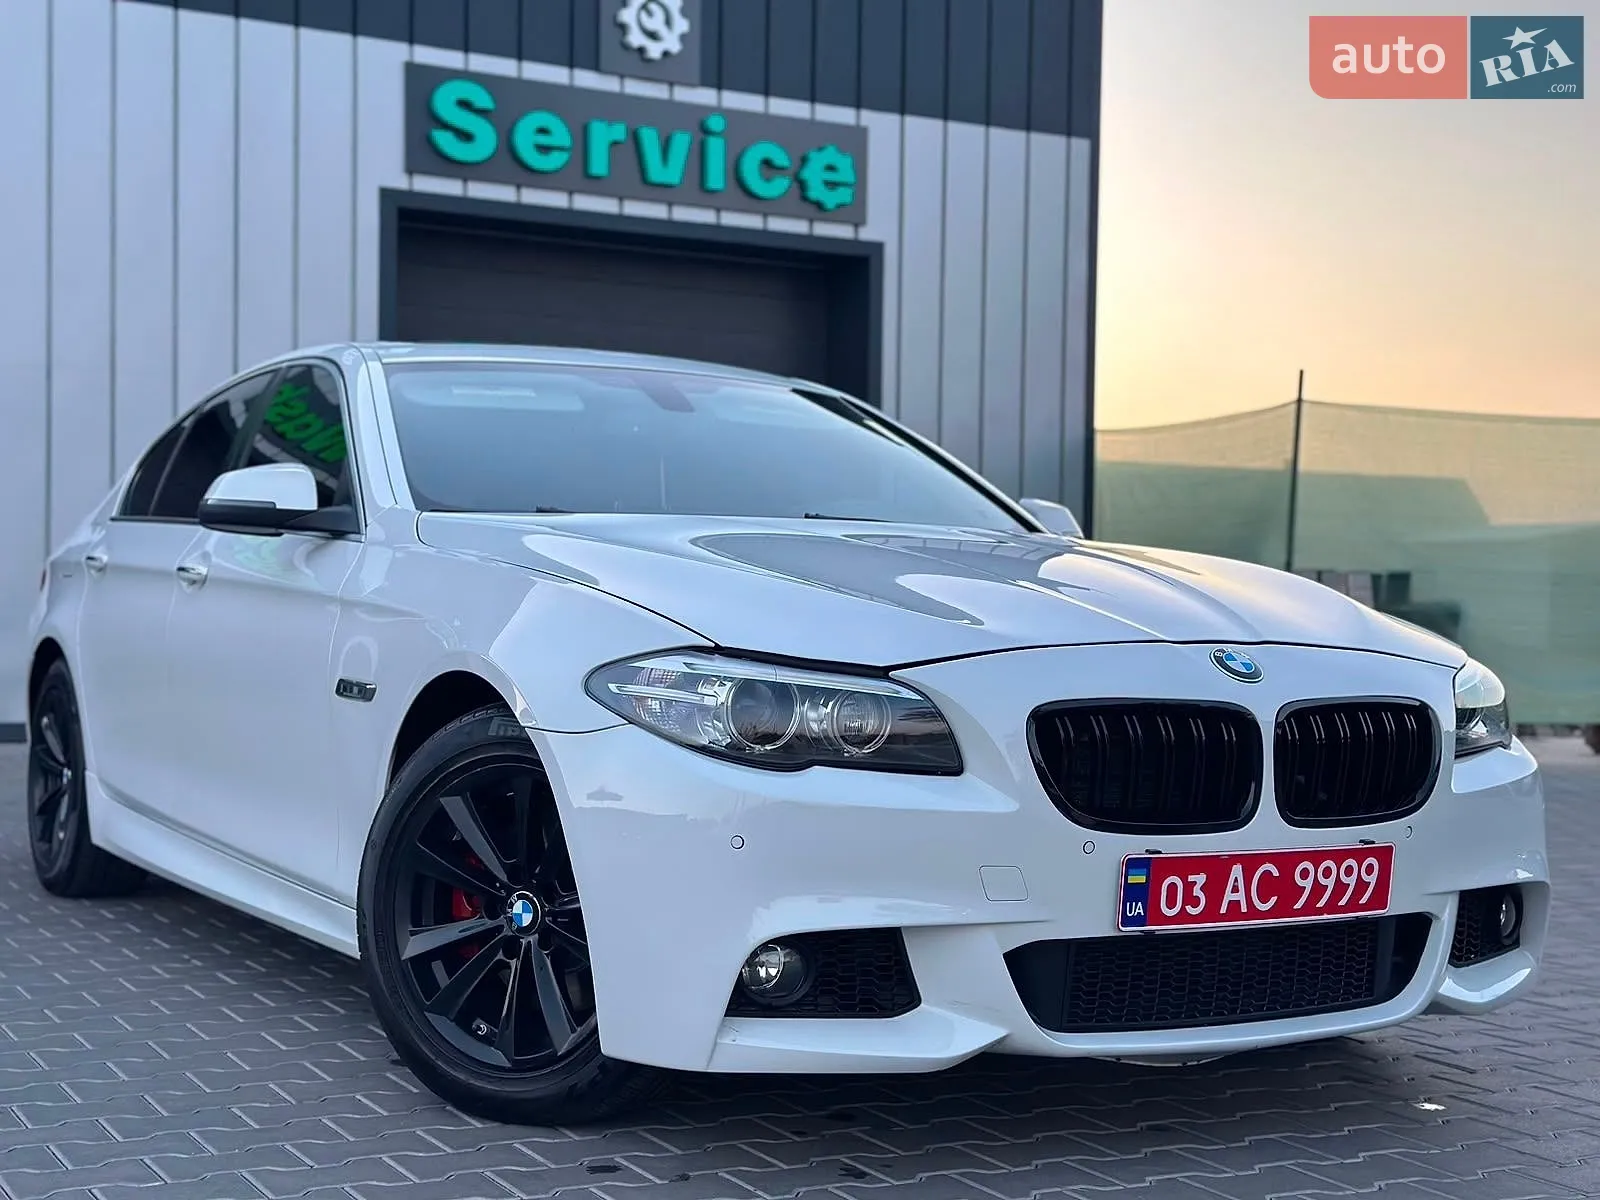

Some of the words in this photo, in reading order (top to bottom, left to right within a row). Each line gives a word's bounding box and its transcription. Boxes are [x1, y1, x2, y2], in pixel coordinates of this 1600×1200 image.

[428, 78, 857, 210] Service
[1126, 901, 1144, 917] UA
[1160, 872, 1207, 917] 03
[1219, 862, 1280, 914] AC
[1293, 856, 1379, 909] 9999
